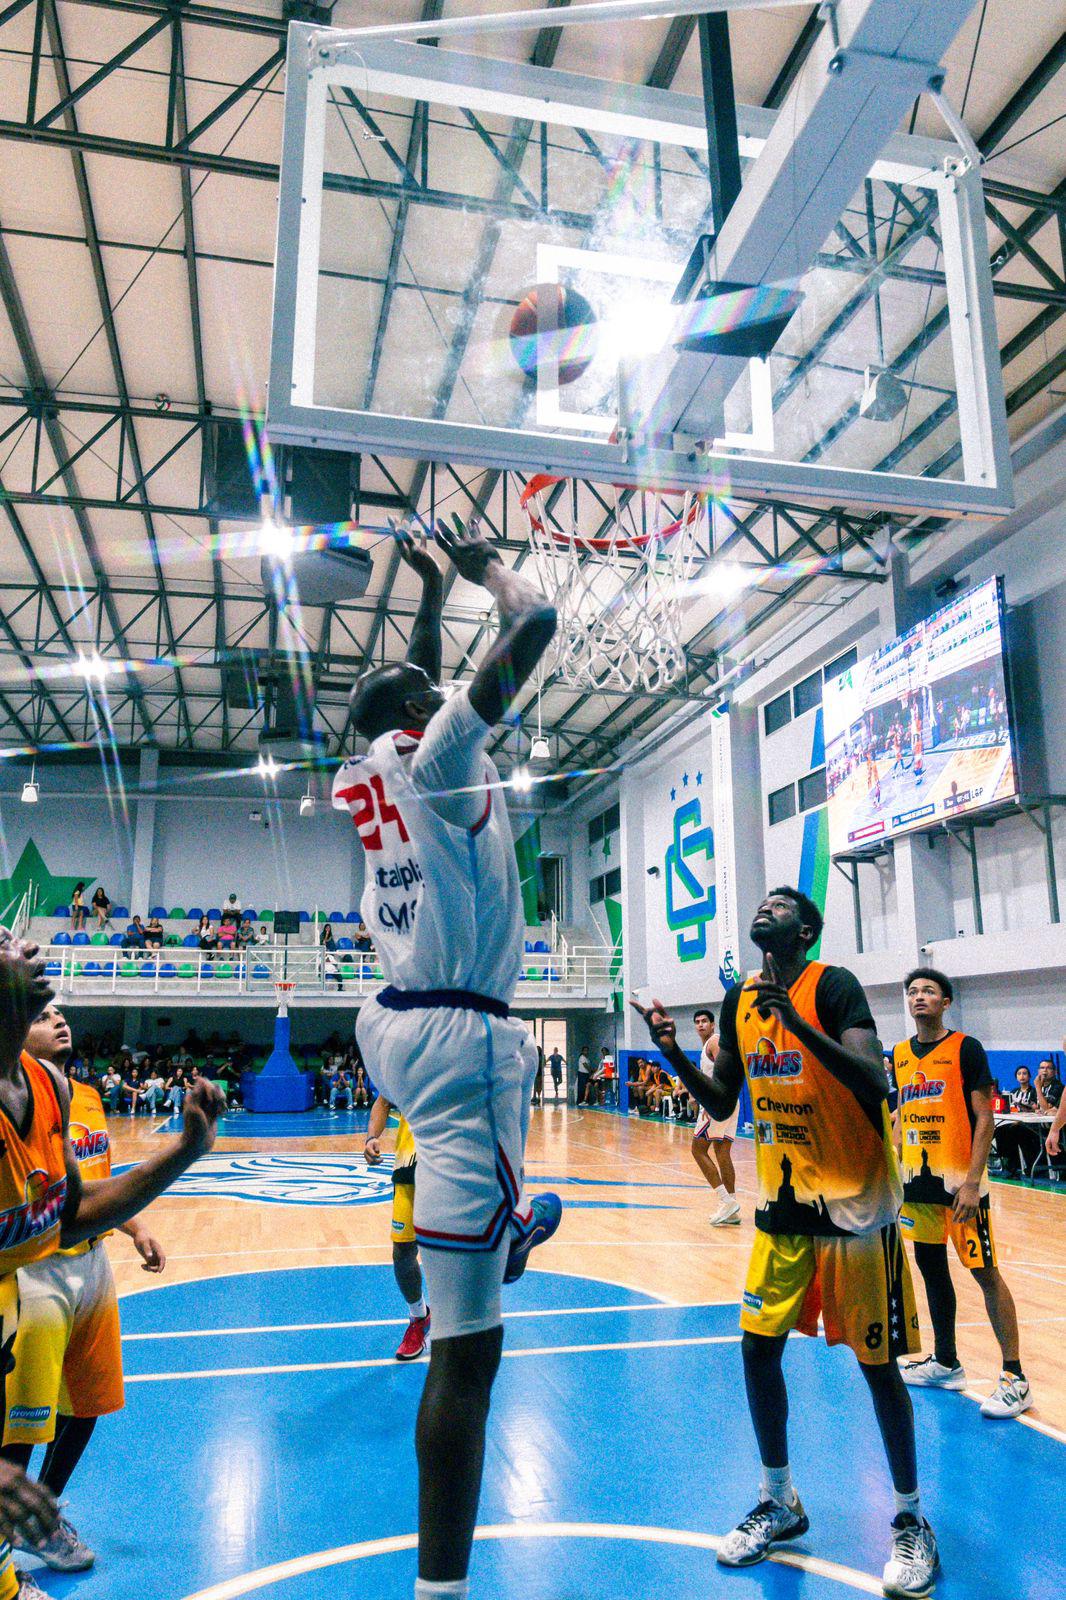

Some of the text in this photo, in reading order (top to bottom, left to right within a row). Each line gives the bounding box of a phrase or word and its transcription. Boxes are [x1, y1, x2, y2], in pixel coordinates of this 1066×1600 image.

[335, 773, 410, 850] 24
[376, 858, 424, 891] tapli
[756, 1097, 814, 1116] Chevron
[967, 1239, 978, 1259] 2
[865, 1321, 884, 1350] 8
